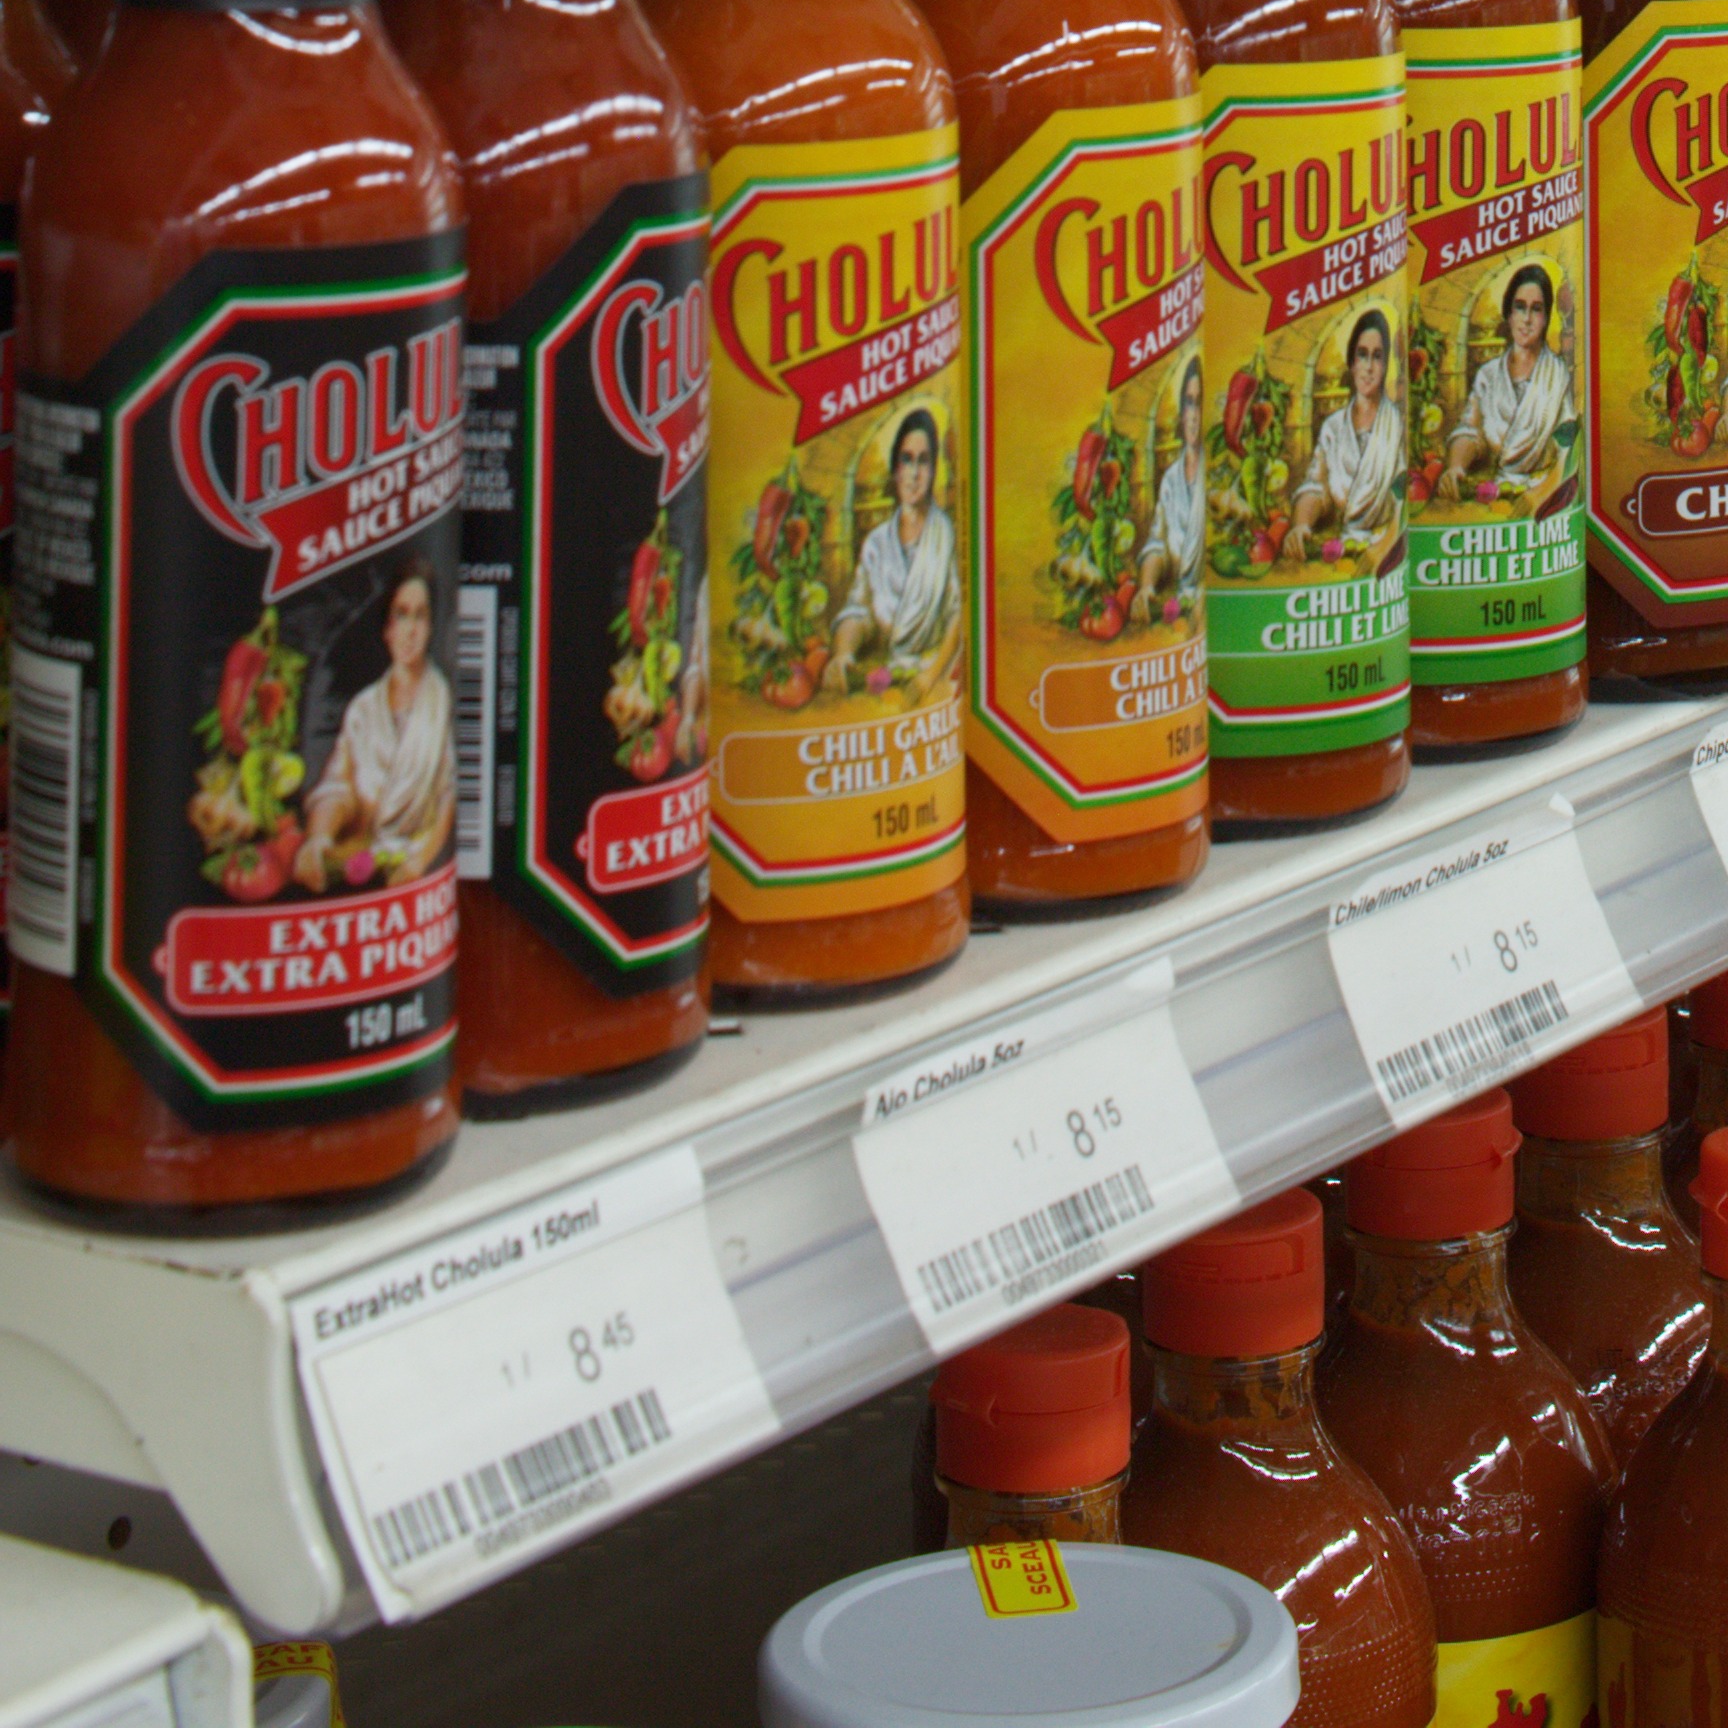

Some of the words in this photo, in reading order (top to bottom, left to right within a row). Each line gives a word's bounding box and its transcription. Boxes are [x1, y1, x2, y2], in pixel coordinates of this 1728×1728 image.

[1478, 195, 1523, 225] HOT
[1531, 171, 1578, 210] SAUCE
[1440, 222, 1519, 266] SAUCE
[861, 322, 911, 370] HOT
[1440, 528, 1519, 552] CHILI
[1525, 519, 1571, 549] LIME
[1508, 552, 1533, 578] ET
[1539, 542, 1578, 570] LIME
[1480, 600, 1515, 626] 150
[1521, 596, 1545, 622] mL
[872, 802, 908, 838] 150
[1335, 877, 1421, 926] Chile/limon
[1425, 851, 1479, 889] Cholula
[1483, 840, 1509, 863] 5oz
[269, 909, 406, 951] EXTRA
[190, 954, 348, 993] EXTRA
[913, 1056, 986, 1101] Cholula
[314, 1276, 424, 1340] ExtraHot
[432, 1239, 524, 1291] Cholula
[532, 1200, 600, 1256] 150ml
